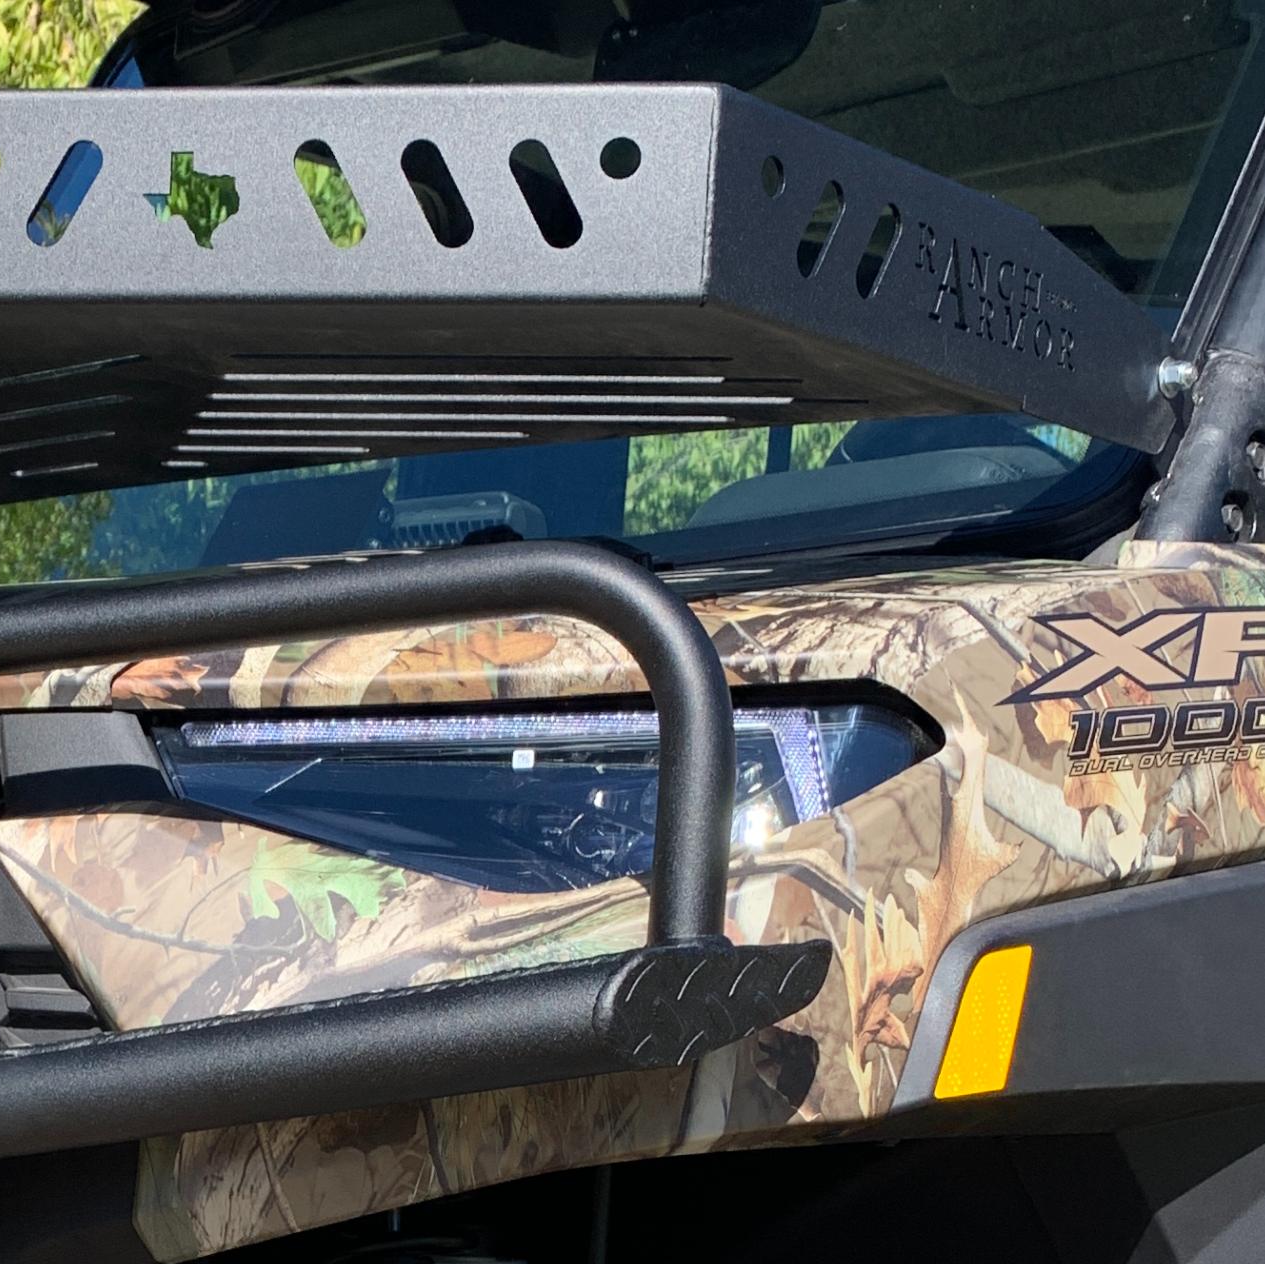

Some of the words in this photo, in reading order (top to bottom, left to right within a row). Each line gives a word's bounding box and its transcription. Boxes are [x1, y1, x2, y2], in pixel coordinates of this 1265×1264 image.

[914, 221, 1045, 316] RANCH
[927, 238, 1076, 373] ARMOR
[1068, 756, 1134, 778] DUAL
[1138, 745, 1254, 770] OVERHEAD
